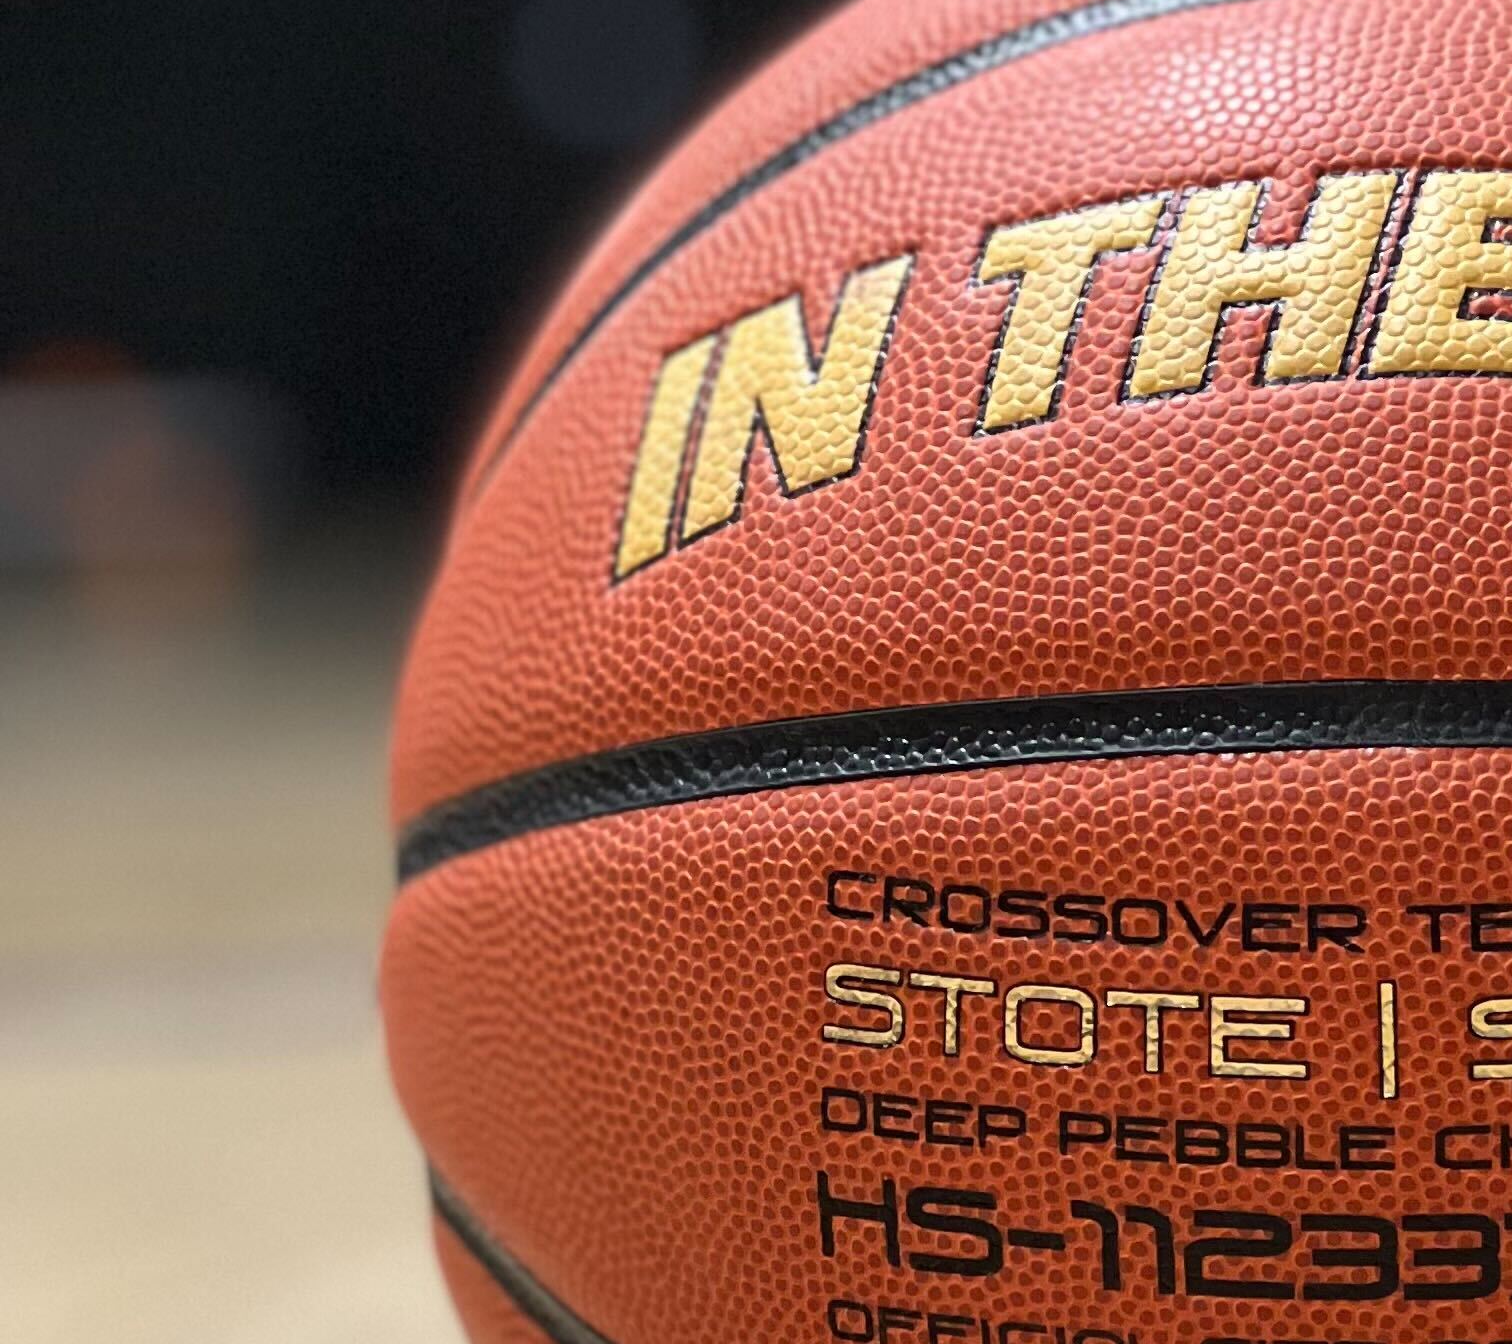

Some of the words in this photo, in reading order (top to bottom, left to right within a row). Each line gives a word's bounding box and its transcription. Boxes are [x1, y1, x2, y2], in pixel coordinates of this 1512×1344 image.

[612, 252, 916, 586] IN
[826, 870, 1366, 953] CROSSOVER
[822, 962, 1309, 1082] STOTE
[821, 1087, 1027, 1148] DEEP
[1058, 1111, 1396, 1171] PEBBLE
